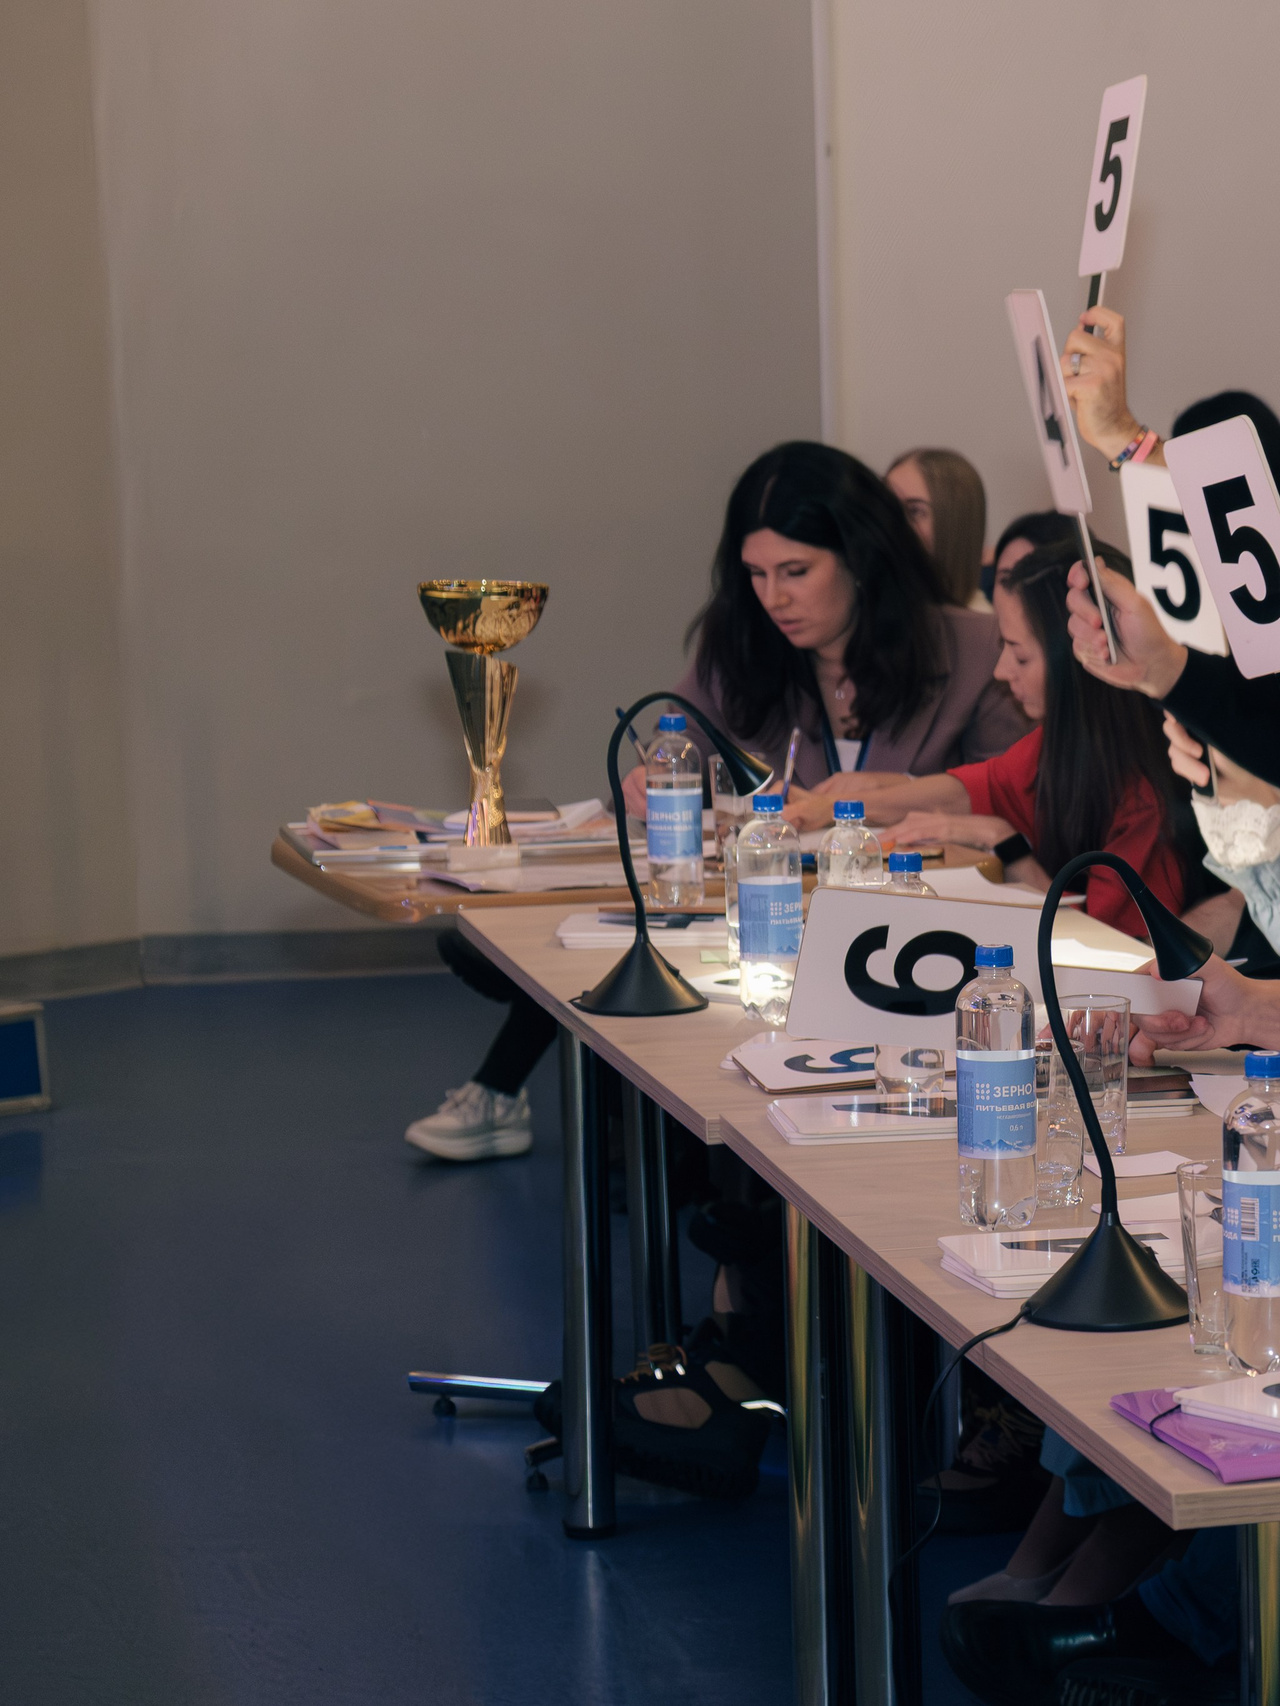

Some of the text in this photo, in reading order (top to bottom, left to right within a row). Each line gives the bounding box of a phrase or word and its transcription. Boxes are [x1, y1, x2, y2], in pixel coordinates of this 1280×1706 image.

[1094, 115, 1131, 232] 5
[1147, 505, 1202, 622] 5
[844, 924, 981, 1017] 6
[975, 1103, 1026, 1112] ПИТЬЕВАЯ
[993, 1083, 1033, 1098] ЗЕРНО
